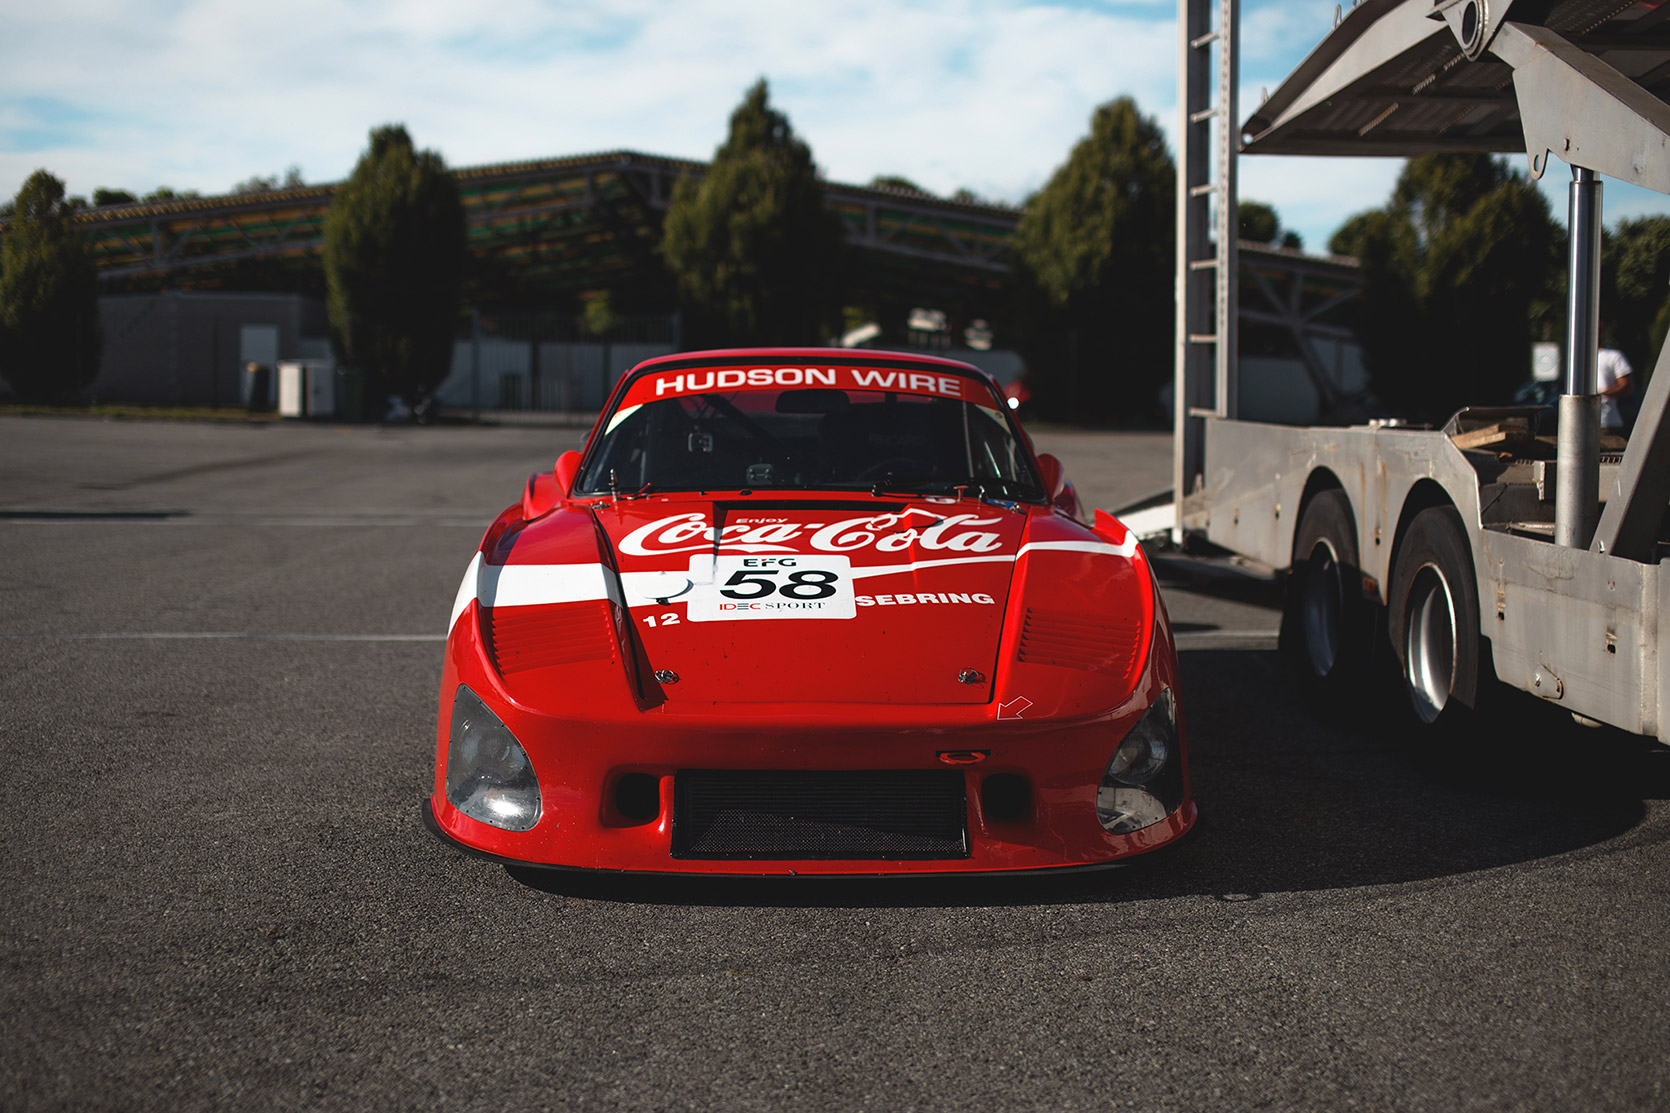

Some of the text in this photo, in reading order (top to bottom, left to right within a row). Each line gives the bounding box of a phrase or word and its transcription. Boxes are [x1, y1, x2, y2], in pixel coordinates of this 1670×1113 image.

[655, 368, 961, 397] HUDSON WIRE
[735, 516, 788, 525] Enjoy
[619, 508, 1003, 557] Coca-Cola
[743, 557, 797, 567] EFG
[719, 569, 839, 600] 58
[719, 602, 826, 611] IDEC SPORT
[854, 593, 996, 607] SEBRING
[642, 613, 681, 628] 12
